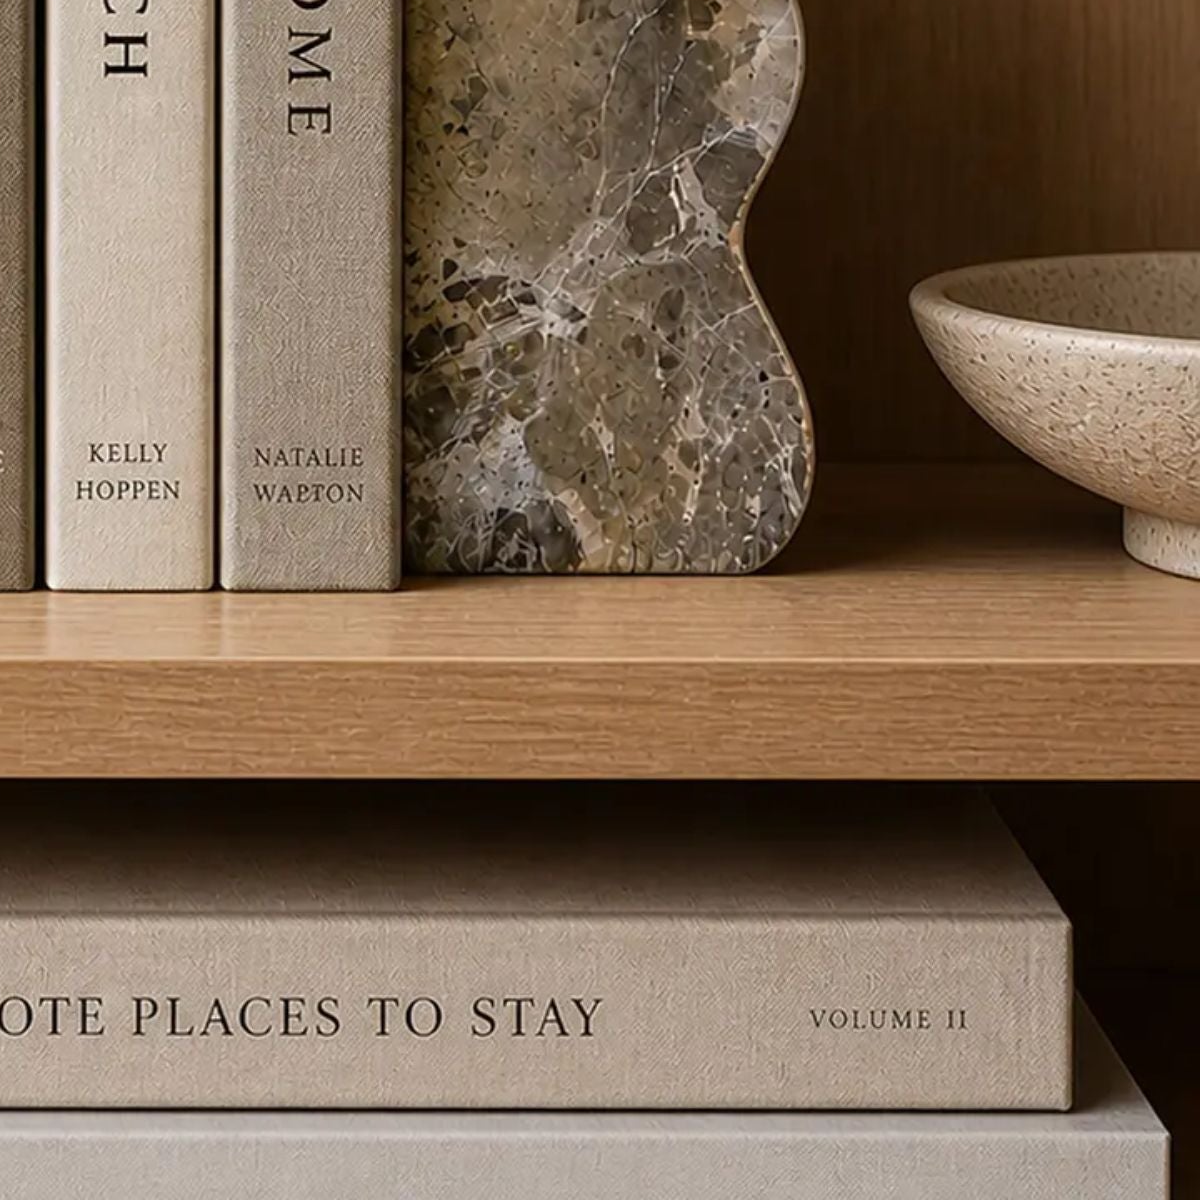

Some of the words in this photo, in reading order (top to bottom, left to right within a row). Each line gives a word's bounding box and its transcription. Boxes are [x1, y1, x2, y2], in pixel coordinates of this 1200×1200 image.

[90, 443, 167, 463] KELLY
[255, 447, 364, 467] NATALIE
[76, 480, 180, 500] HOPPEN
[133, 997, 340, 1036] PLACES
[368, 997, 442, 1036] TO
[471, 997, 601, 1037] STAY
[809, 1009, 931, 1030] VOLUME
[948, 1009, 966, 1029] II
